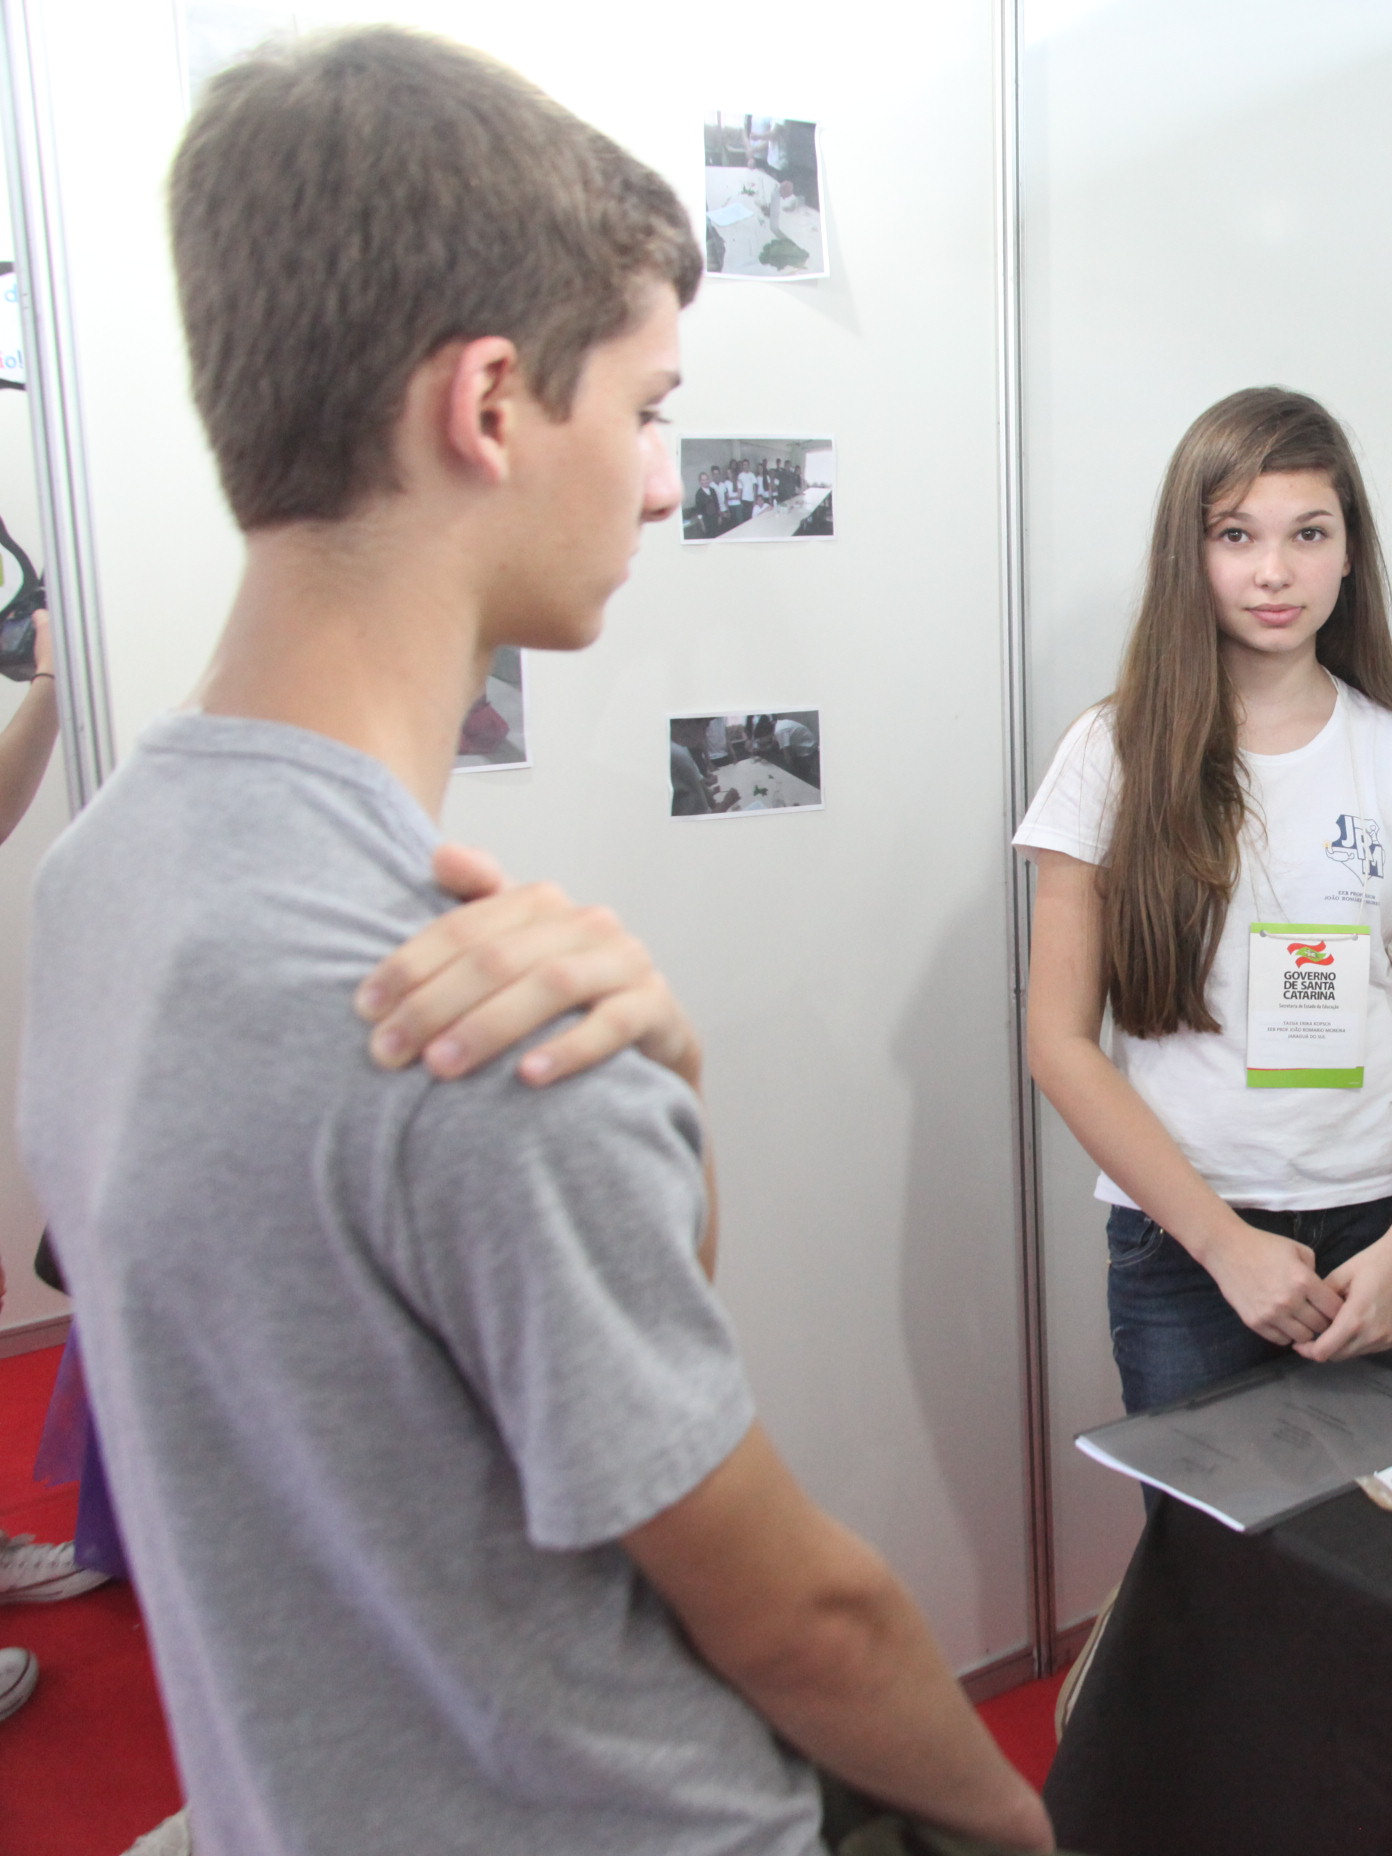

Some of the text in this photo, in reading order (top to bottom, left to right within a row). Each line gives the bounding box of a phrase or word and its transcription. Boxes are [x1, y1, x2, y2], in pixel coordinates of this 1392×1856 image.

[1284, 971, 1336, 981] GOVERNO
[1284, 981, 1335, 990] DE SANTA
[1283, 990, 1335, 1000] CATARINA
